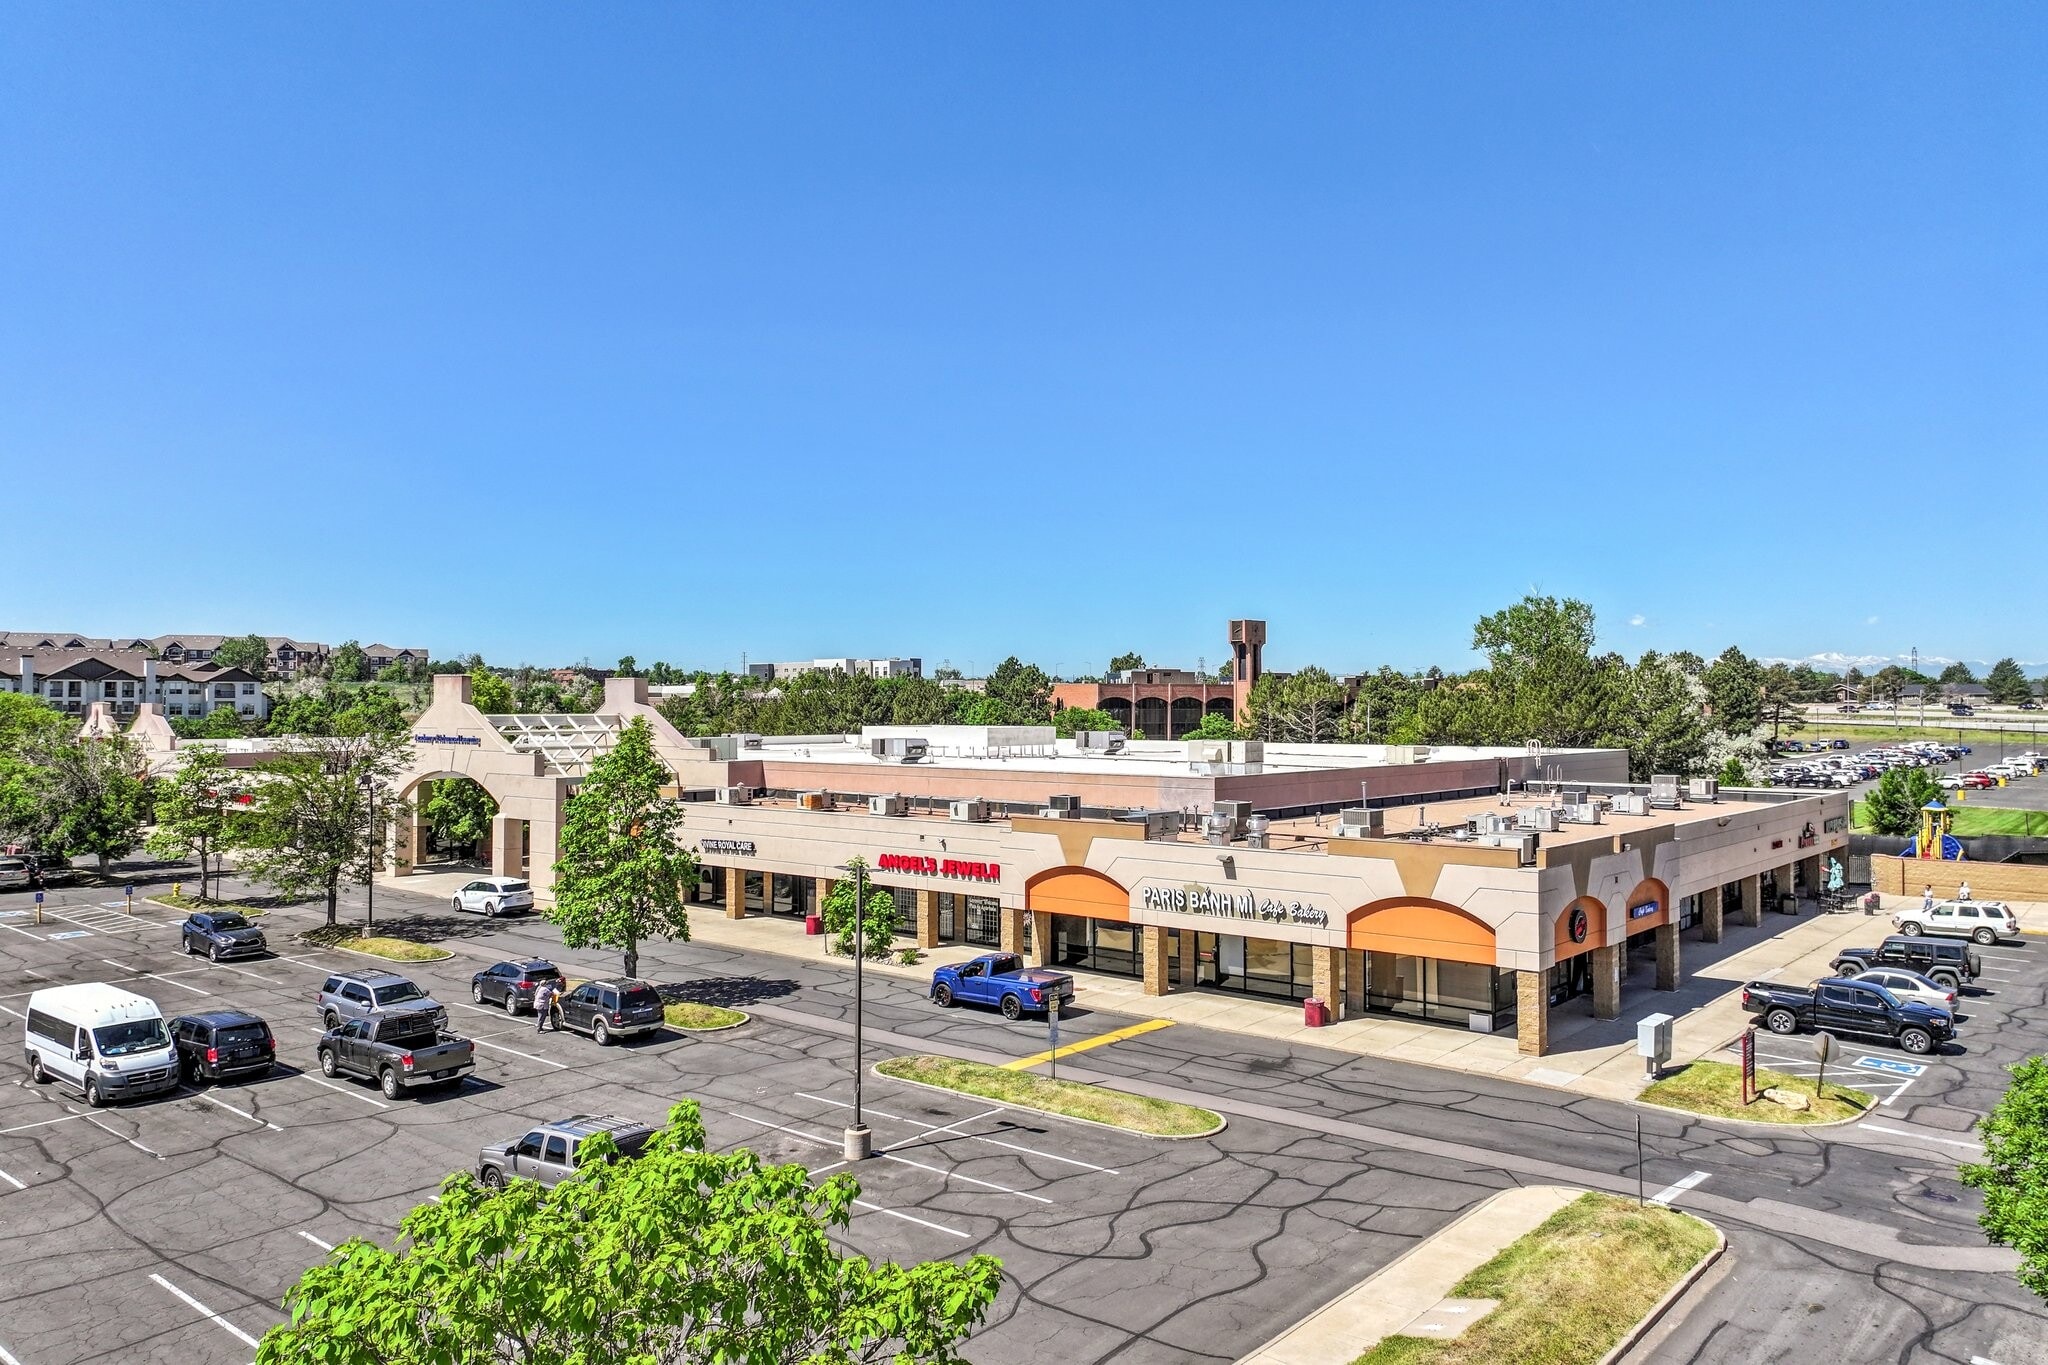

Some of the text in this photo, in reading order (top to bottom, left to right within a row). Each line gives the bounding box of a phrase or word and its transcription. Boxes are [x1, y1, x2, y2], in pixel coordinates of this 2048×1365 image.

[718, 841, 736, 850] ROYAL
[736, 842, 752, 851] CARE
[878, 854, 937, 872] ANGEL'S
[1142, 886, 1328, 923] PARIS BÁNH MÌ Cafe Bakery
